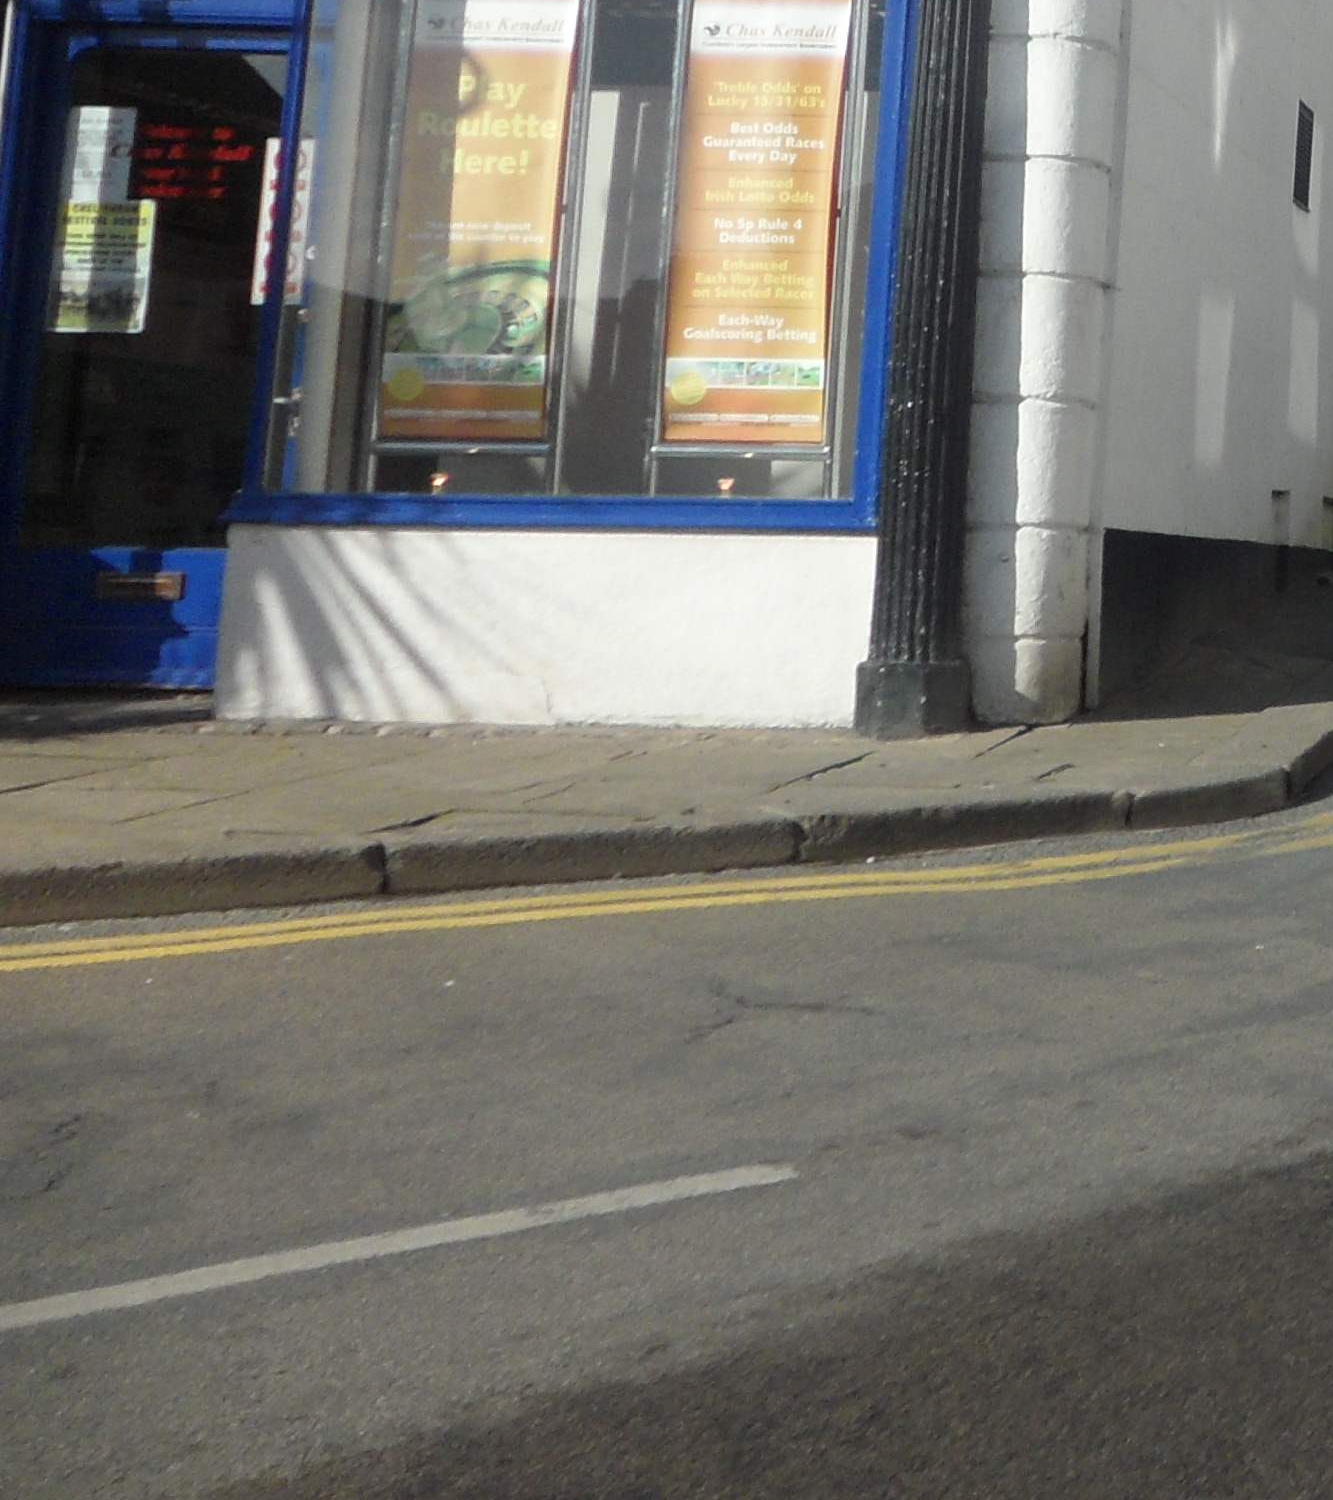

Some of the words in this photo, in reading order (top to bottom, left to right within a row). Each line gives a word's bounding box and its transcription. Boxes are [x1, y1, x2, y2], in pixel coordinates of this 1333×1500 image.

[772, 23, 838, 39] Kendall
[730, 121, 760, 135] Best
[763, 121, 799, 135] Odds
[728, 150, 766, 165] Every
[769, 150, 797, 165] Day
[713, 217, 734, 230] No
